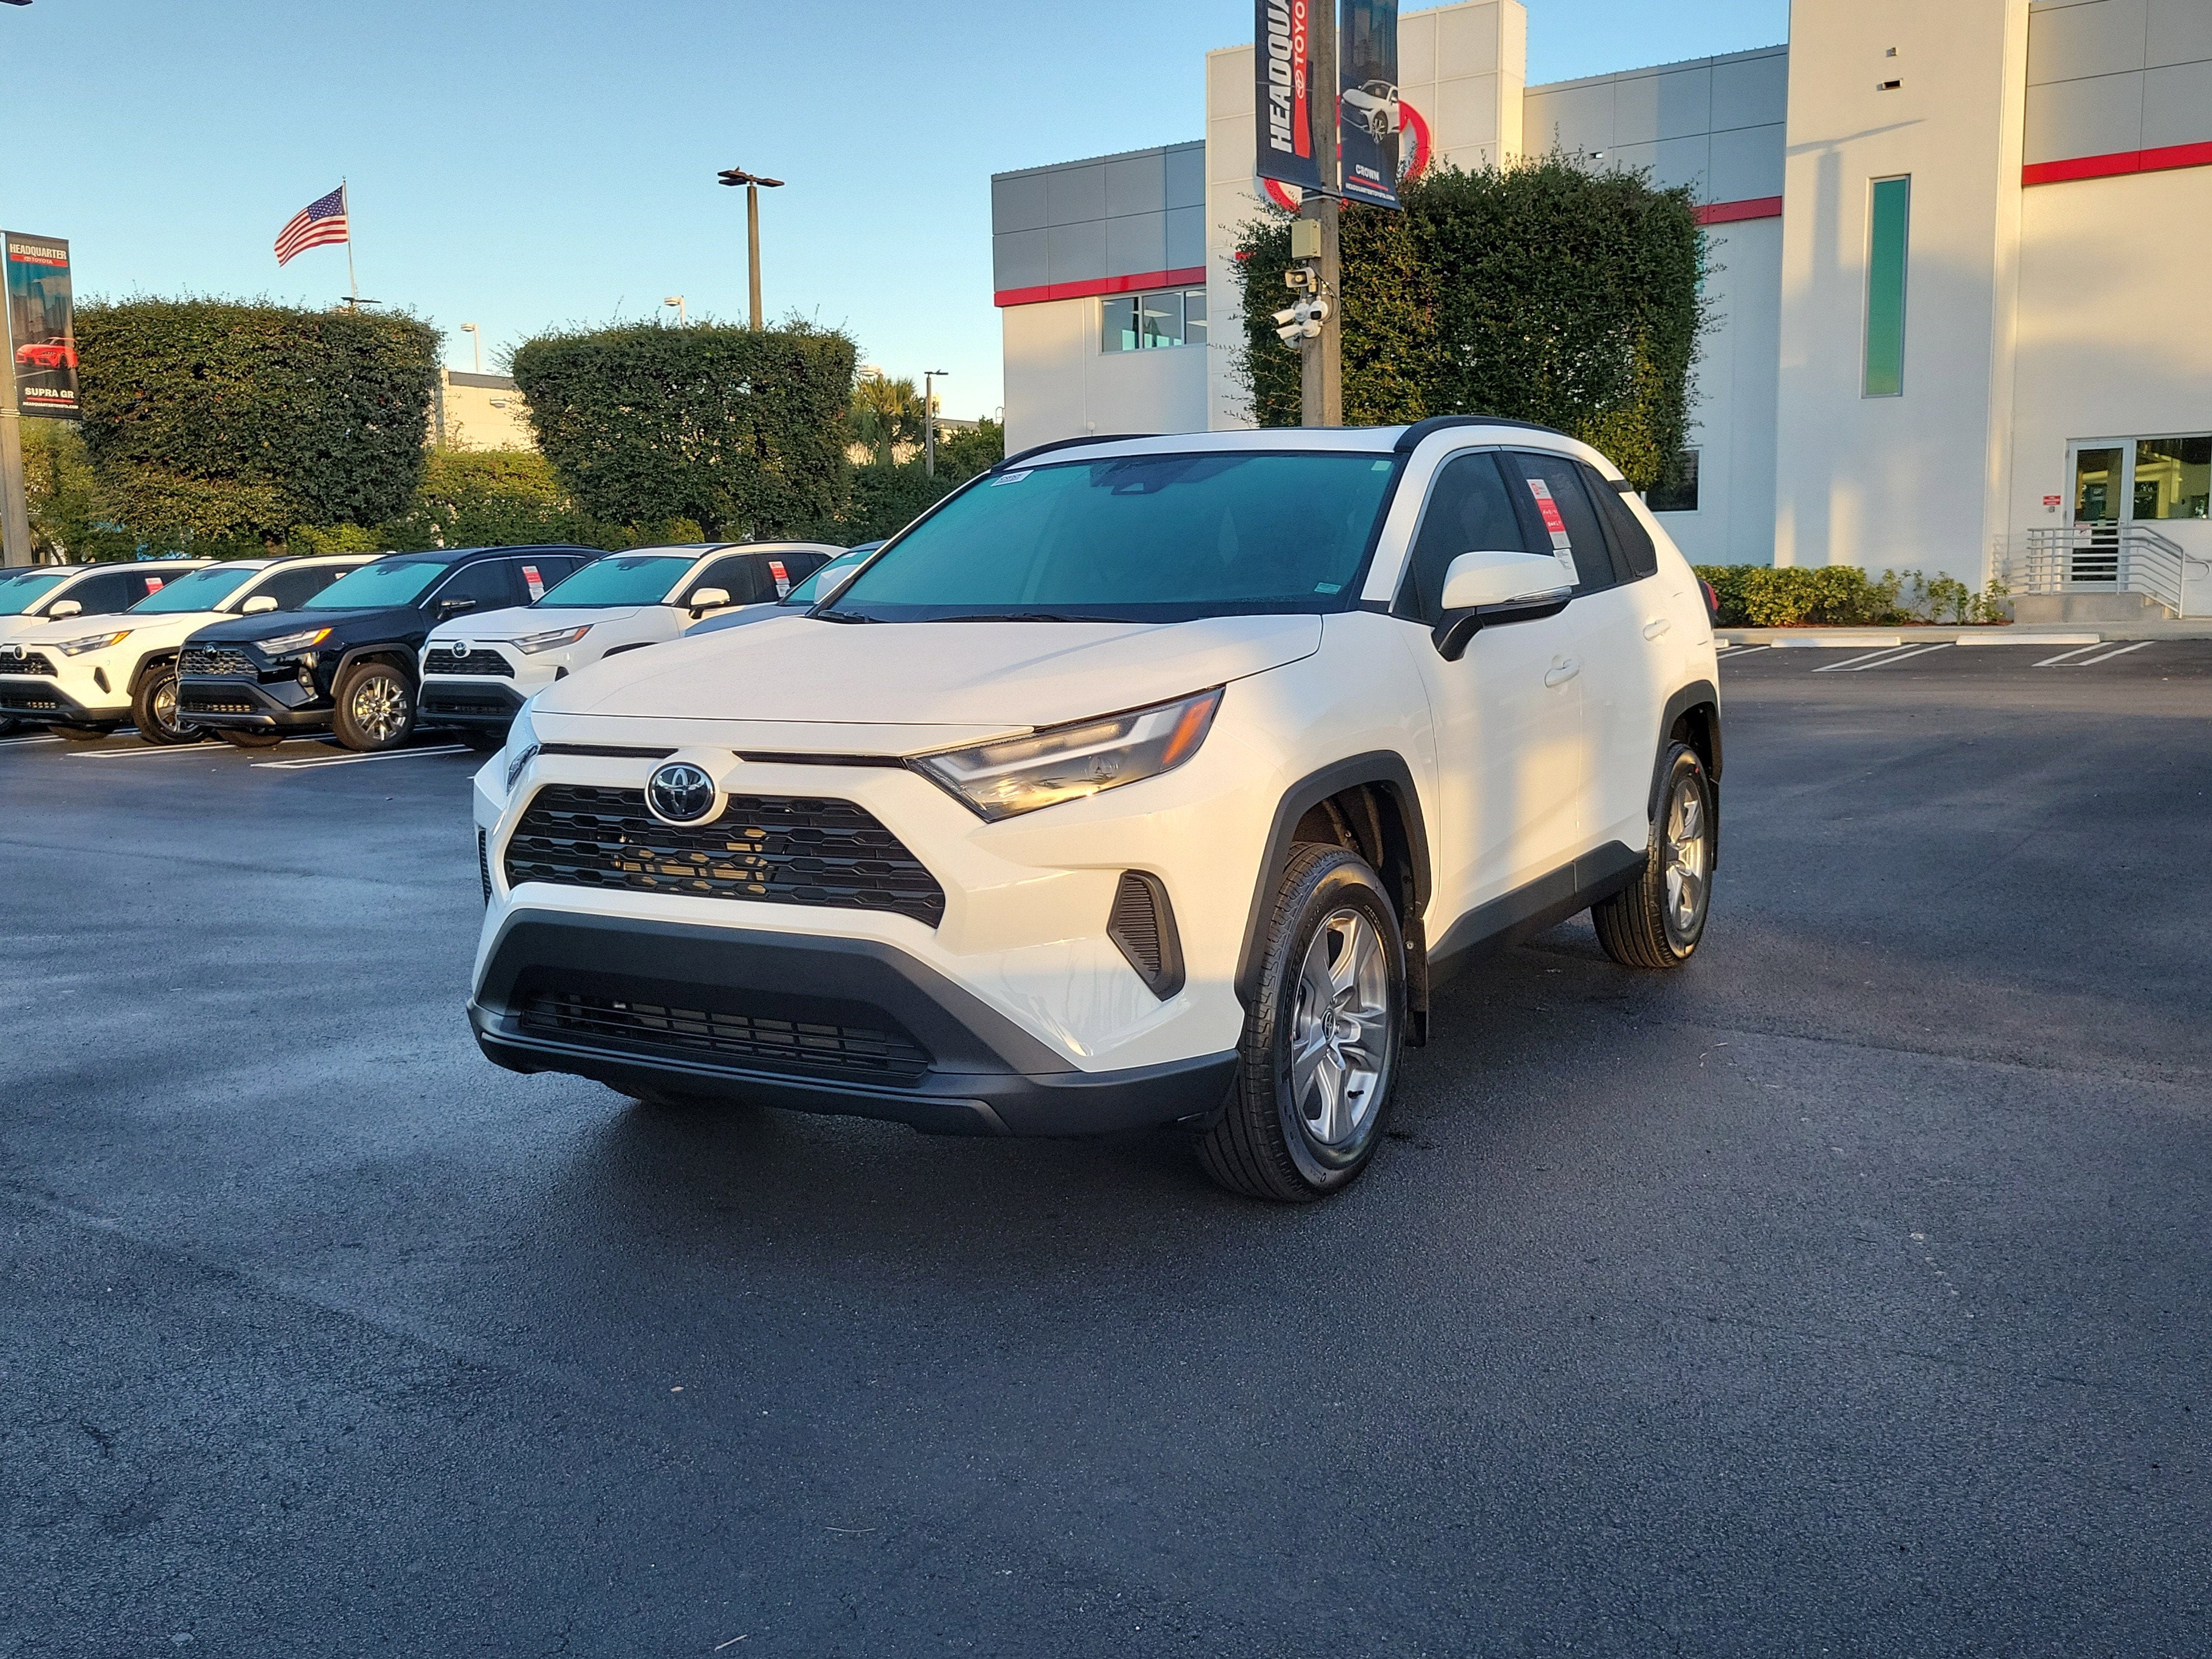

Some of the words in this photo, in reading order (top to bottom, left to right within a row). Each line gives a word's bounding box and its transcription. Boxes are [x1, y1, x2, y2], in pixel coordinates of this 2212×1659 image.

[1356, 164, 1380, 182] CROWN
[9, 243, 67, 259] HEADQUARTER
[25, 387, 59, 397] SUPRA
[60, 390, 74, 399] GR
